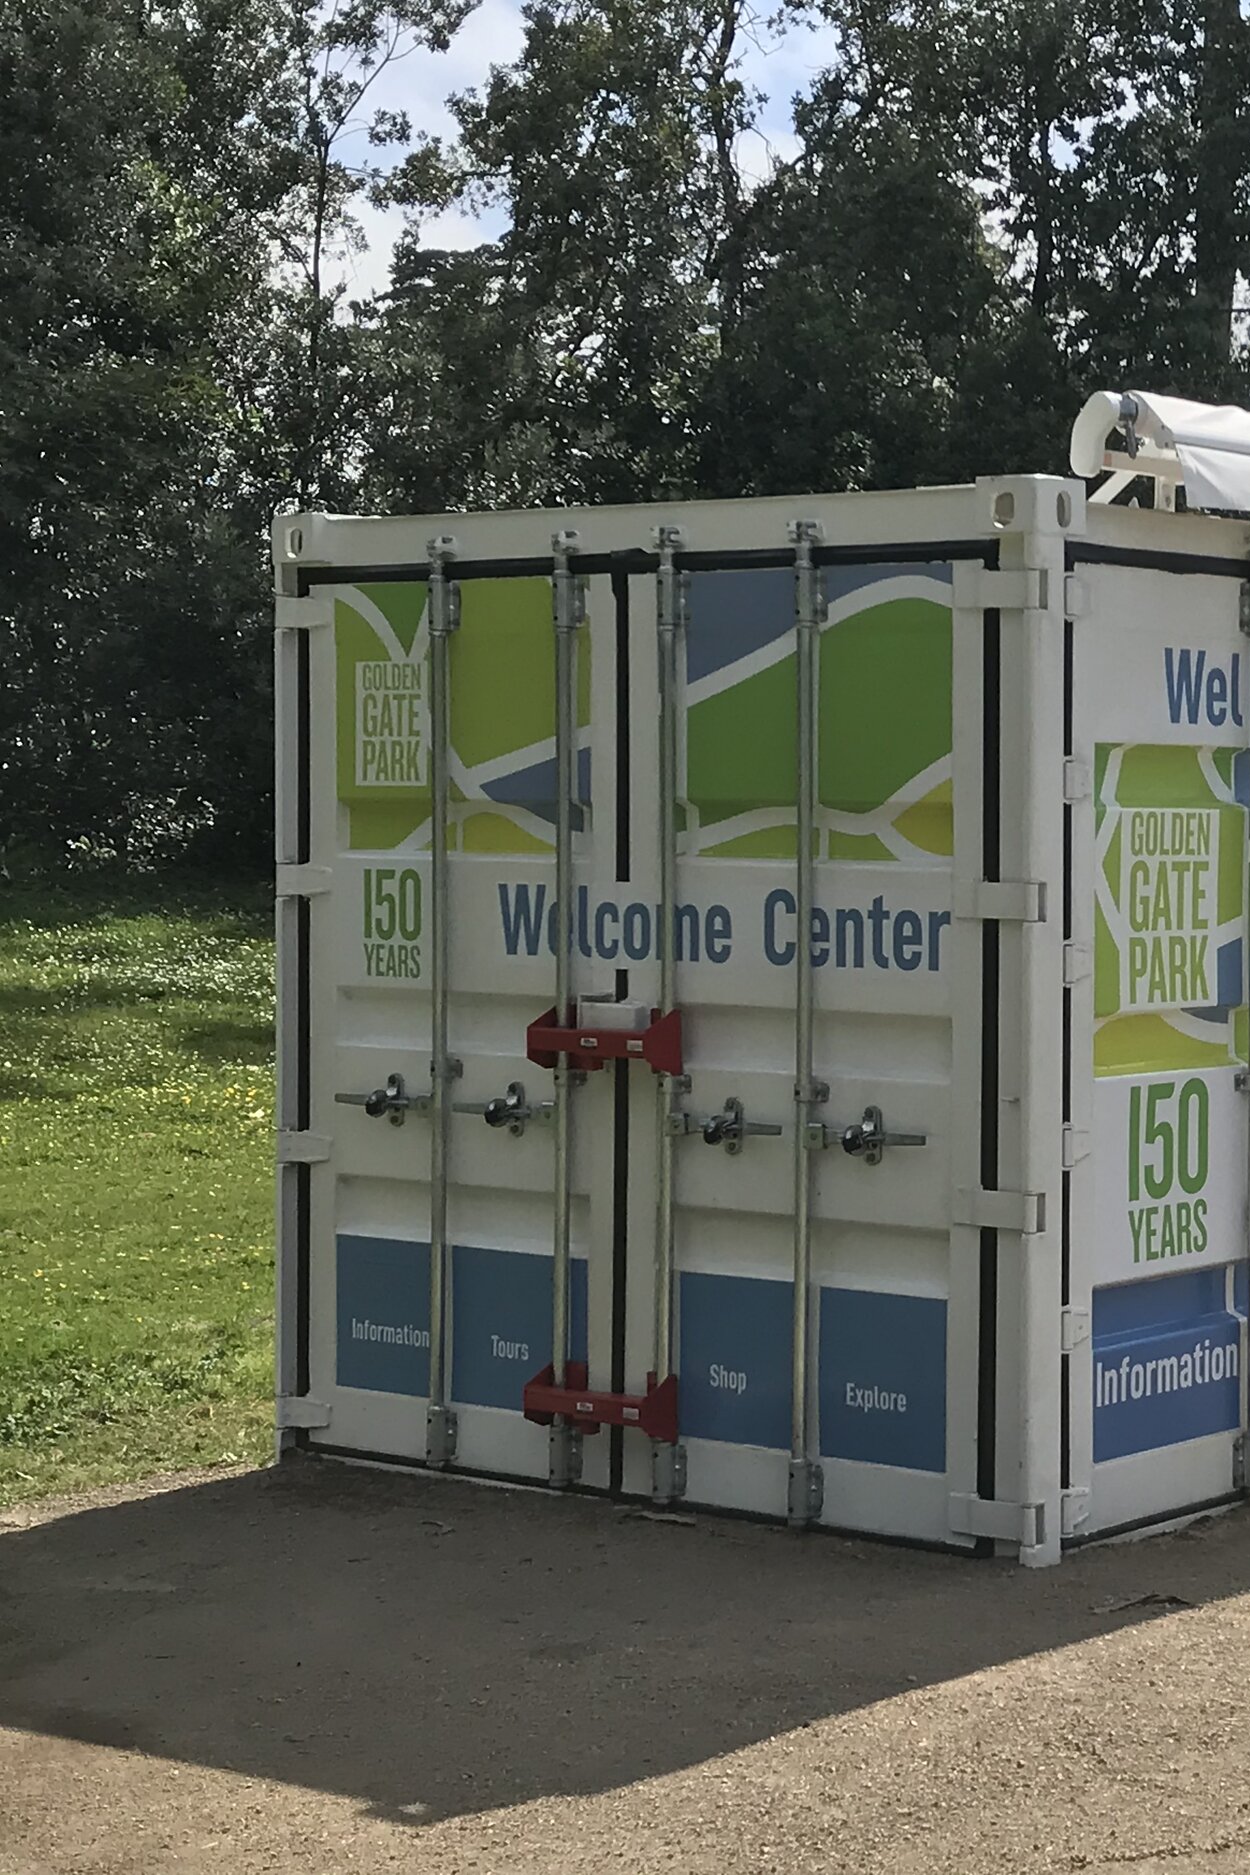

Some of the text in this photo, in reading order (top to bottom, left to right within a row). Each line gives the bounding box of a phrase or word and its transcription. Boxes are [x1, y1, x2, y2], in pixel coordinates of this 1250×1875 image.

[362, 663, 421, 691] GOLDEN
[362, 693, 421, 737] GATE
[362, 739, 420, 781] PARK
[1130, 810, 1210, 857] GOLDEN
[363, 868, 421, 941] 150
[1129, 861, 1209, 933] GATE
[764, 888, 952, 971] Center
[363, 943, 421, 979] YEARS
[1129, 935, 1209, 1005] PARK
[1128, 1077, 1209, 1202] 150
[1128, 1198, 1208, 1264] YEARS
[352, 1318, 430, 1348] Information
[491, 1334, 529, 1361] Tours
[709, 1363, 747, 1395] Shop
[1096, 1339, 1238, 1408] Information
[846, 1382, 907, 1413] Explore
